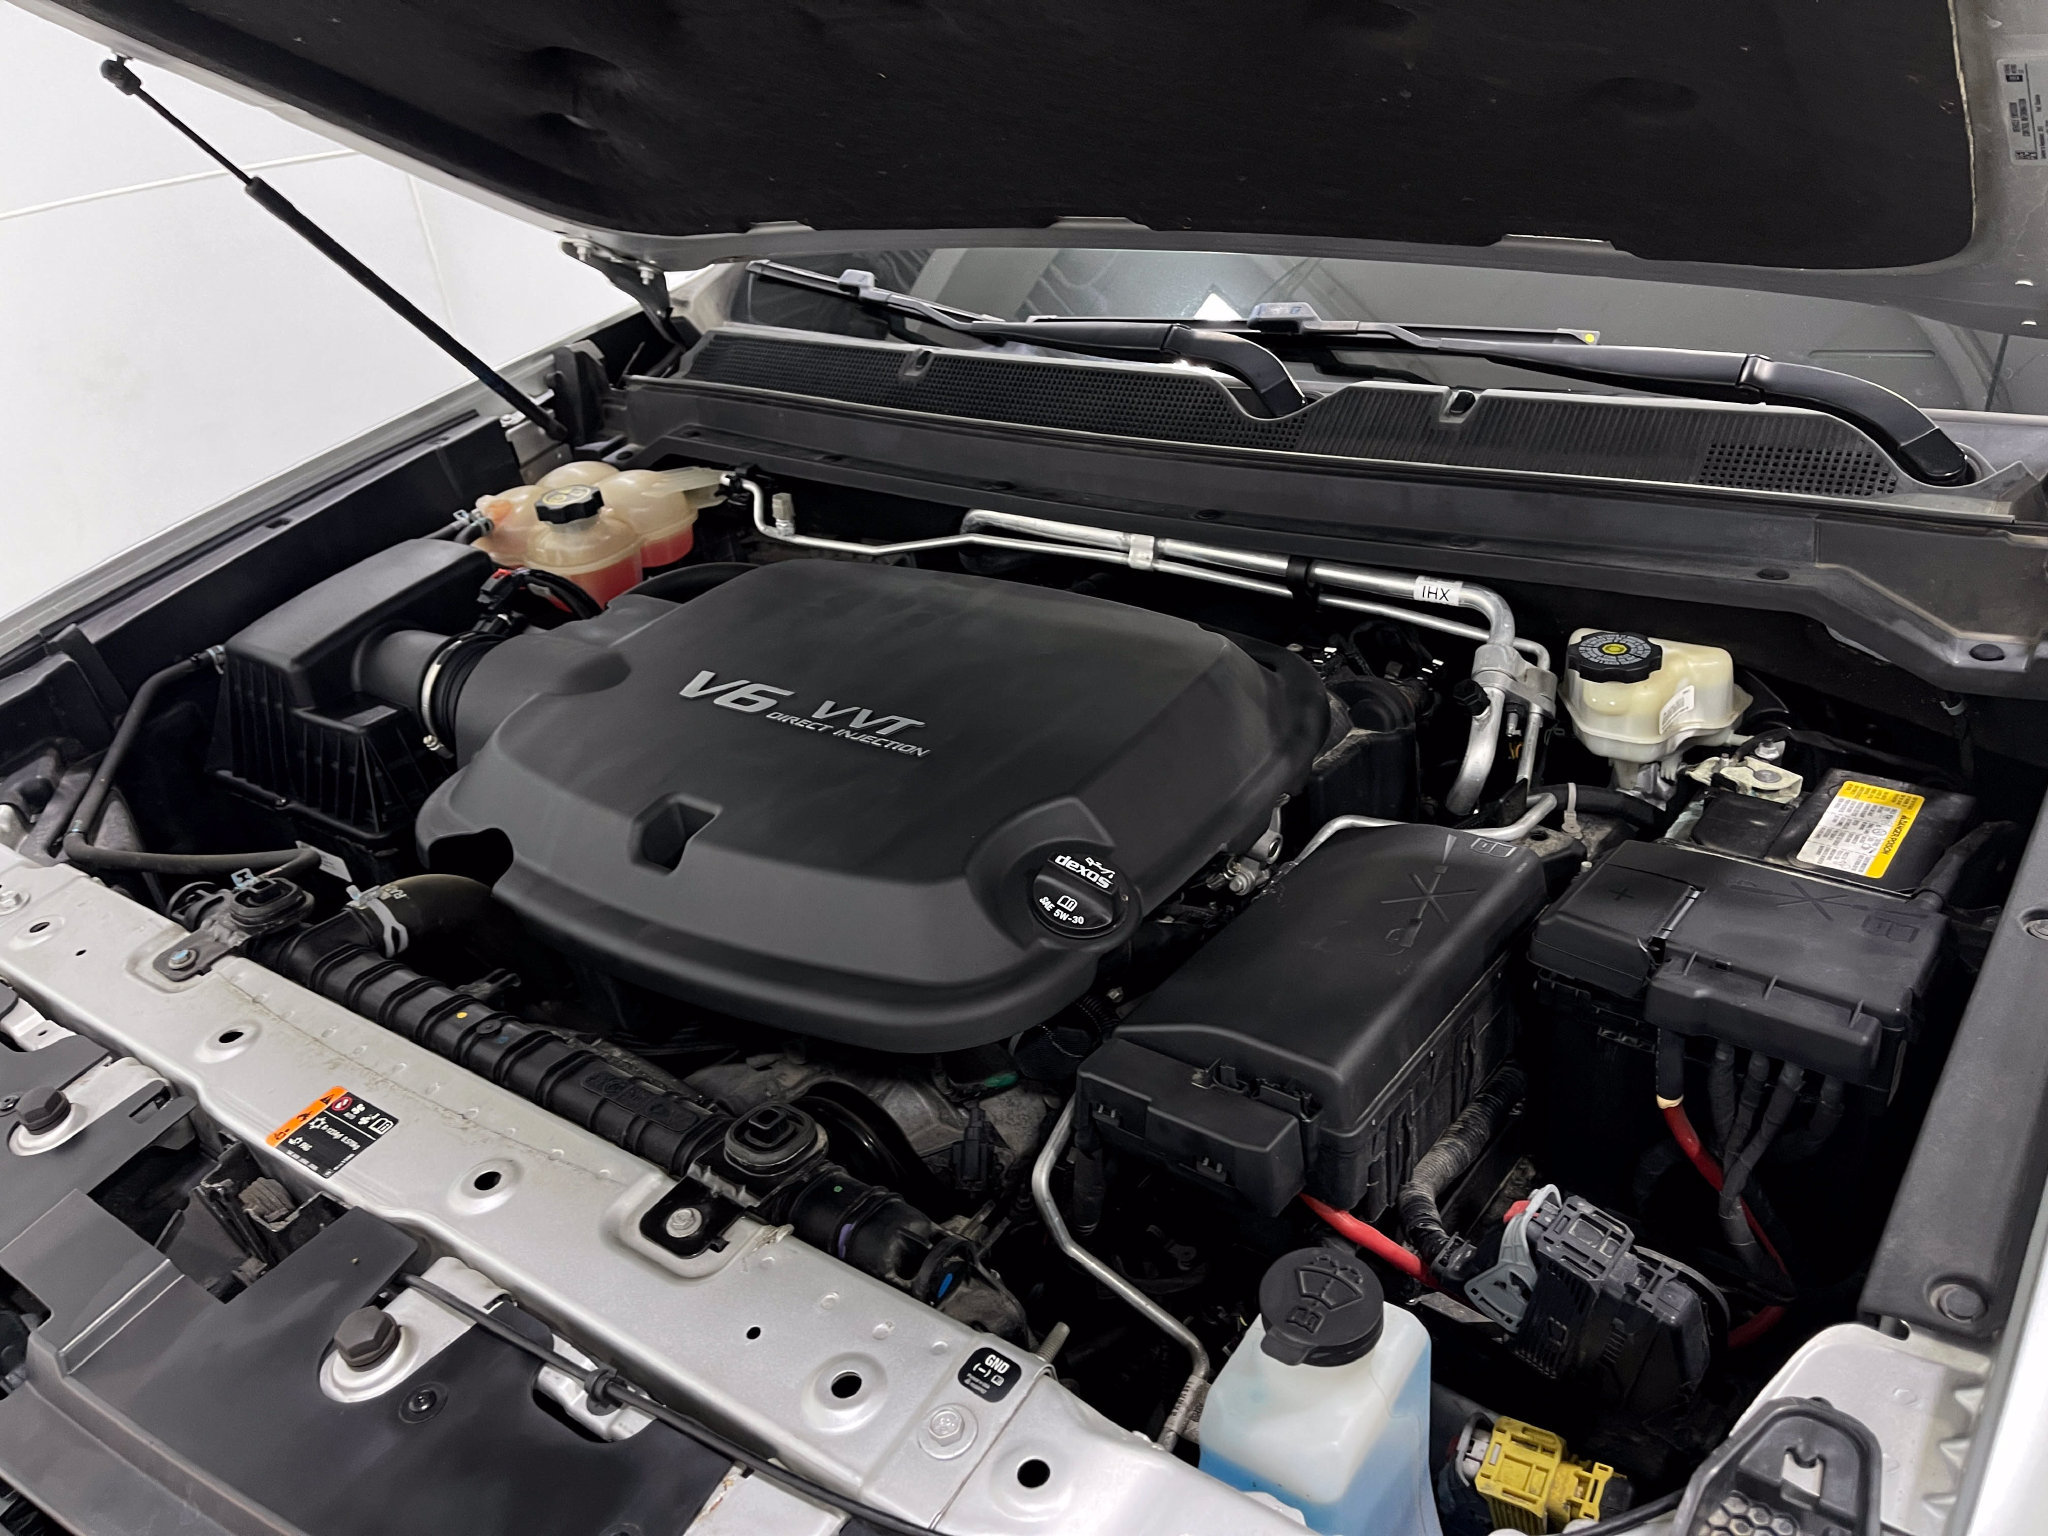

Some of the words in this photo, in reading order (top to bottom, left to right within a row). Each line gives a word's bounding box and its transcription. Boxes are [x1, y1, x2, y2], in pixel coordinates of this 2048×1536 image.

[1422, 585, 1450, 601] IHX
[679, 670, 796, 713] V6
[811, 700, 926, 735] VVT
[766, 711, 834, 732] DIRECT
[832, 728, 931, 757] INJECTION
[1054, 855, 1113, 889] dexos
[1039, 896, 1056, 912] SAE
[1053, 909, 1085, 925] 5W-30
[984, 1354, 1010, 1374] GND
